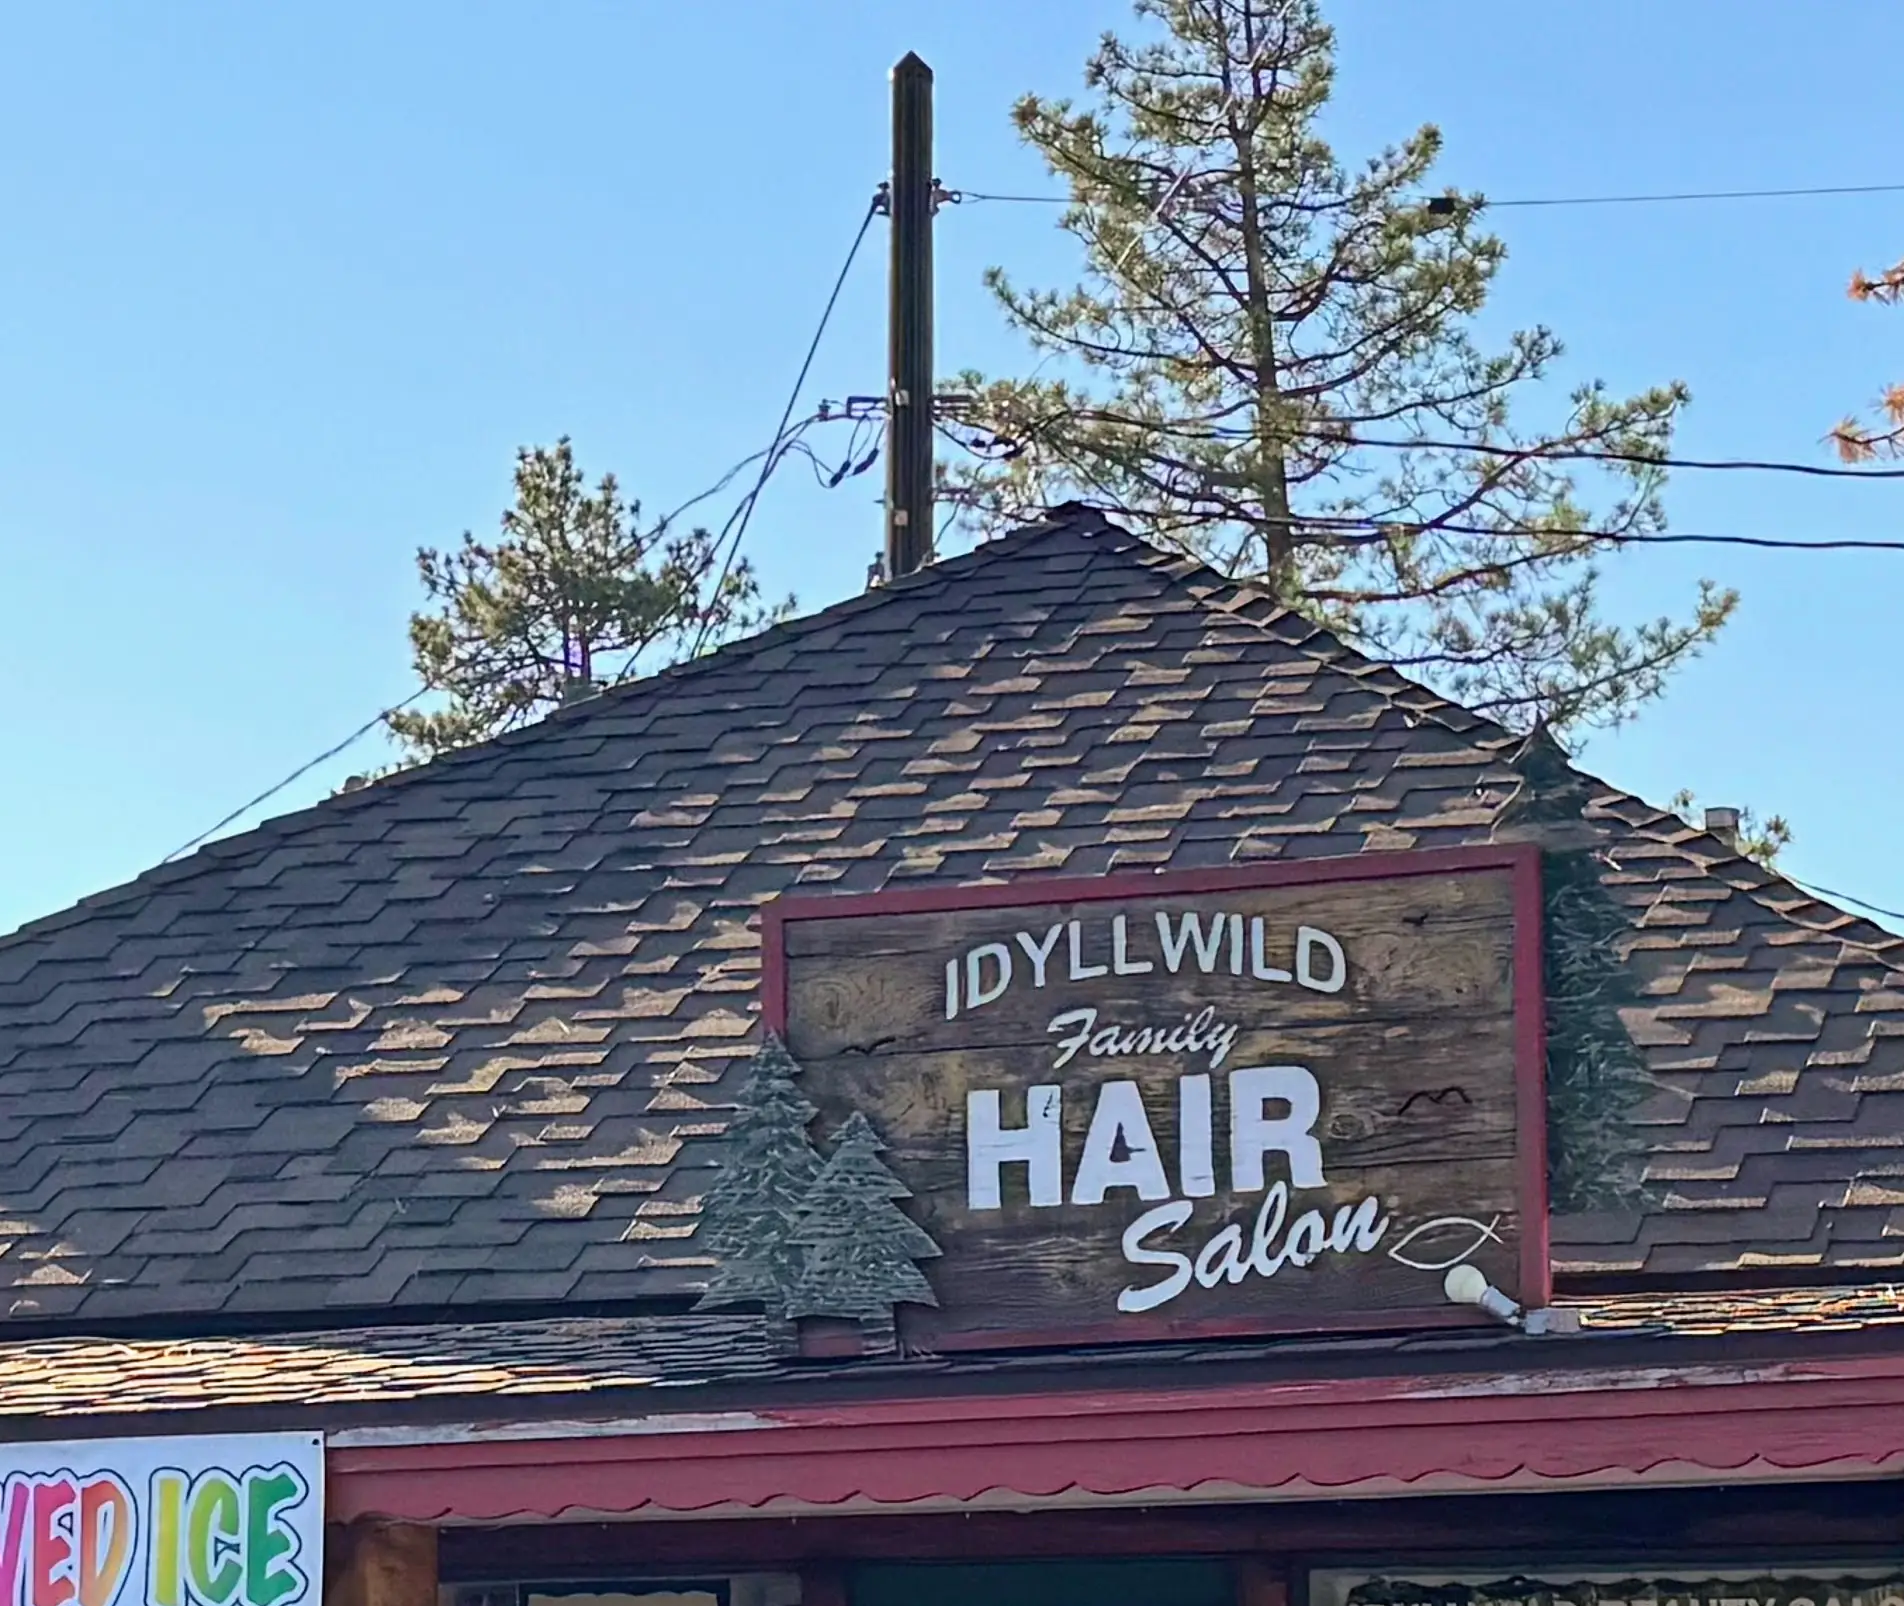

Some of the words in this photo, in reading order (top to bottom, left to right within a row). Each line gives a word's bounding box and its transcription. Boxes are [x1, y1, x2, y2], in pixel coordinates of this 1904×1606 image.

[945, 911, 1346, 1020] IDYLLWILD
[1046, 1004, 1239, 1070] Family
[966, 1064, 1327, 1211] HAIR
[1116, 1180, 1391, 1314] Salon
